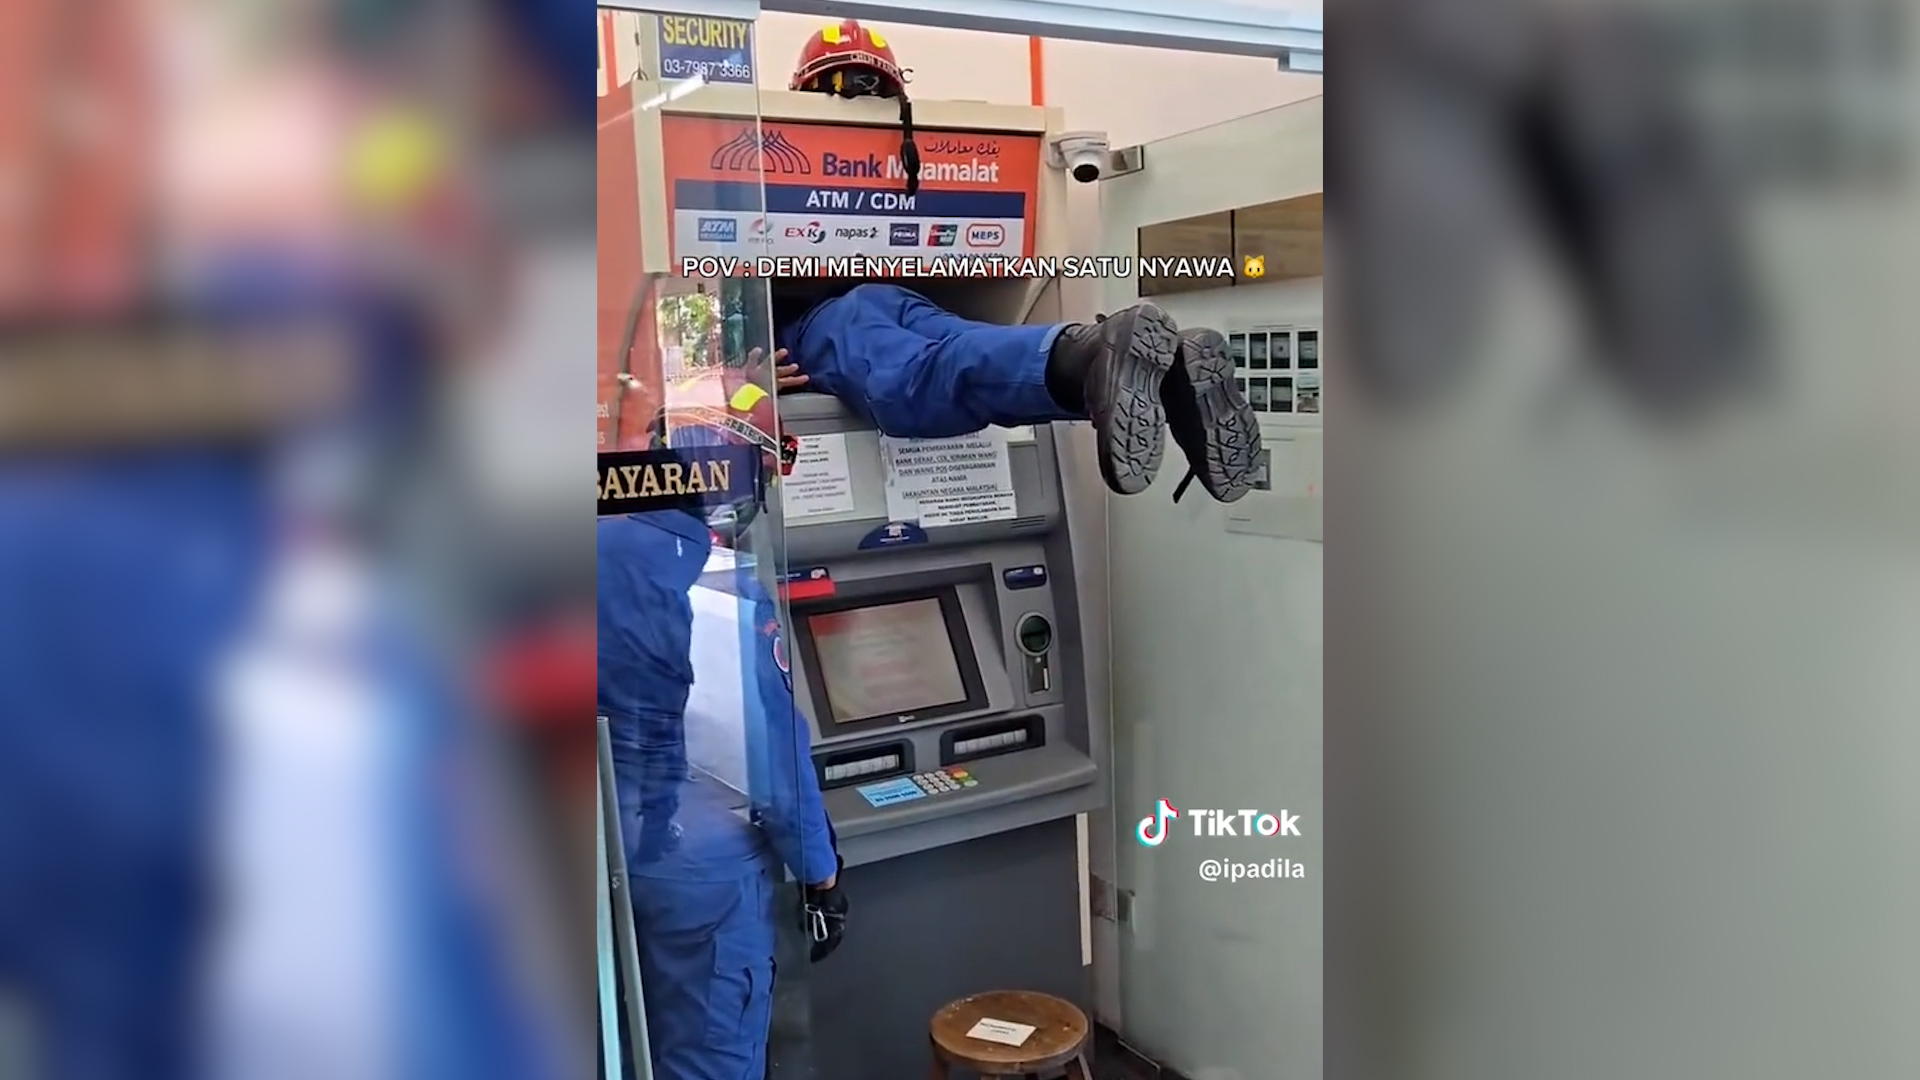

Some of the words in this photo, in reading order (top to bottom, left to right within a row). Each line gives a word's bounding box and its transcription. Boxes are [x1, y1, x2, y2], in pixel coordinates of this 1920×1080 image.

[663, 16, 747, 49] SECURITY
[823, 152, 882, 178] Bank
[806, 190, 848, 209] ATM
[870, 192, 916, 210] CDM
[835, 227, 868, 240] napas
[971, 231, 999, 240] MEPS
[597, 459, 730, 500] AYARAN
